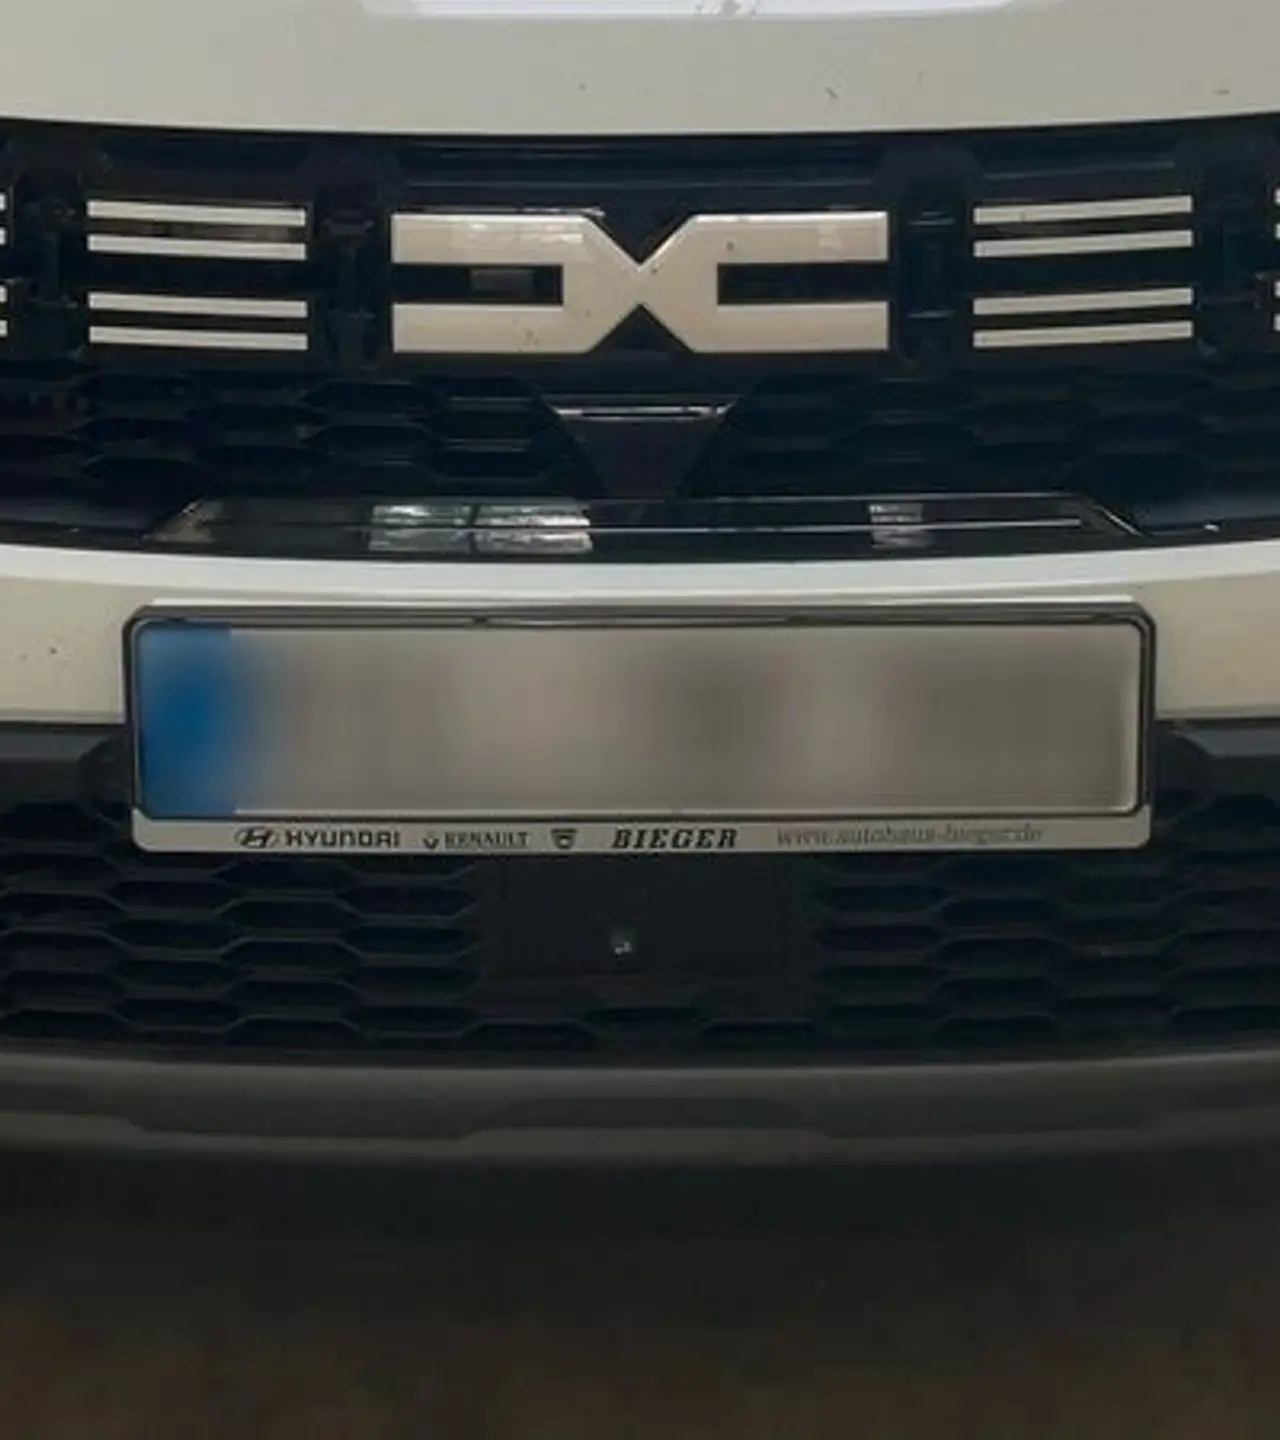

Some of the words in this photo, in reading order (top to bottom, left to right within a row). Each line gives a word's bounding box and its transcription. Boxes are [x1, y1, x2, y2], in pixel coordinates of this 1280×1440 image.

[284, 827, 400, 849] HYUNDAI
[444, 830, 529, 849] RENAULT
[610, 827, 739, 850] BIEGER
